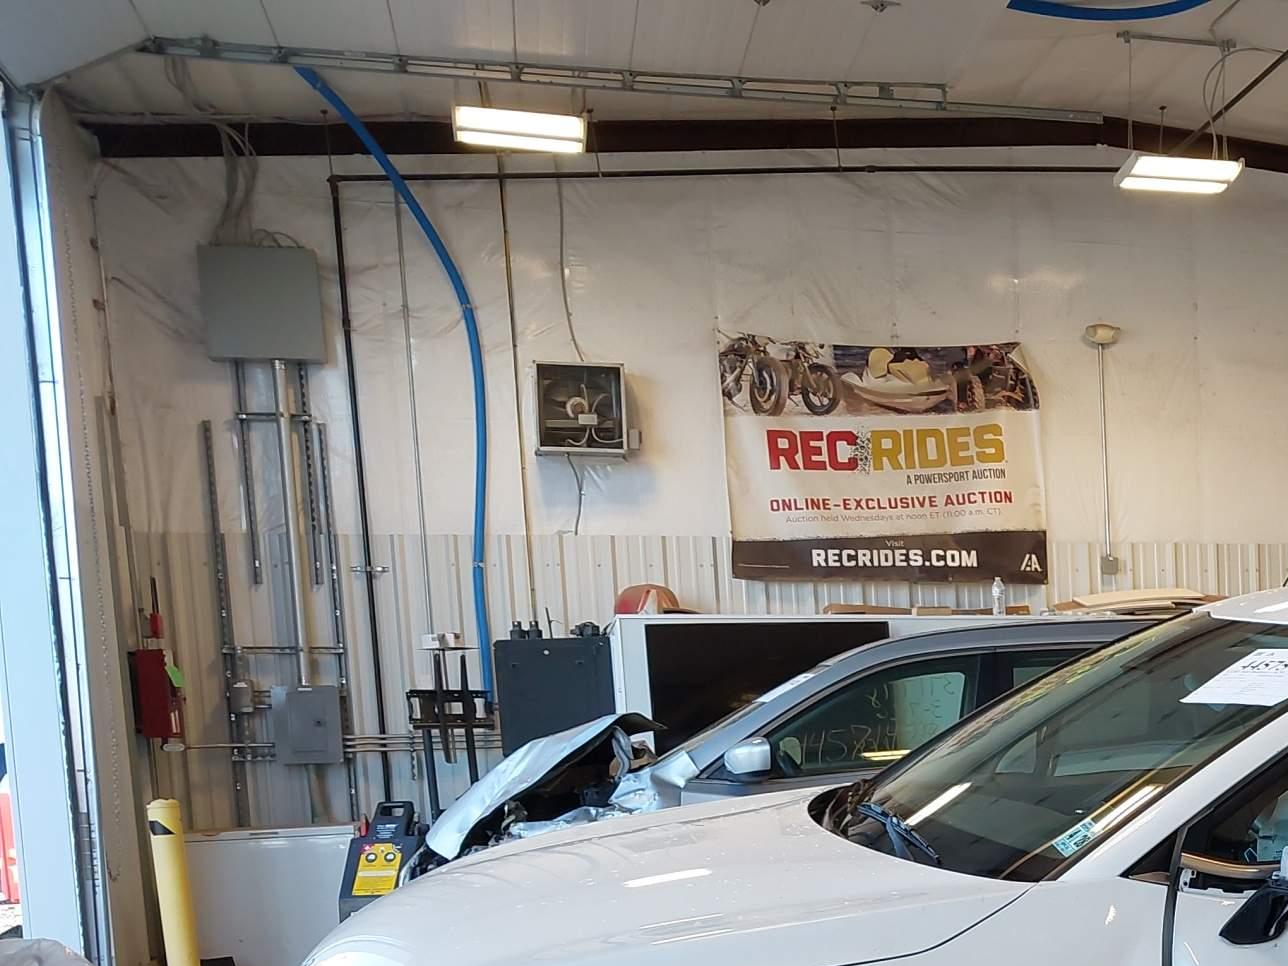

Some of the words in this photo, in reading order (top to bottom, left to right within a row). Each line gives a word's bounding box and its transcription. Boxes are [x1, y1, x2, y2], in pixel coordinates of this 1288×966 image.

[767, 429, 859, 471] REC
[872, 423, 1005, 470] RIDES
[906, 474, 913, 485] A
[914, 470, 970, 485] POWERSPORT
[972, 467, 1006, 481] AUCTION
[770, 495, 938, 512] ONLINE-EXCLUSIVE
[944, 490, 1013, 507] AUCTION
[786, 513, 819, 523] Auction
[820, 513, 838, 522] held
[840, 513, 894, 523] Wednesdays
[929, 511, 940, 519] ET
[811, 550, 978, 568] RECRIDES.COM
